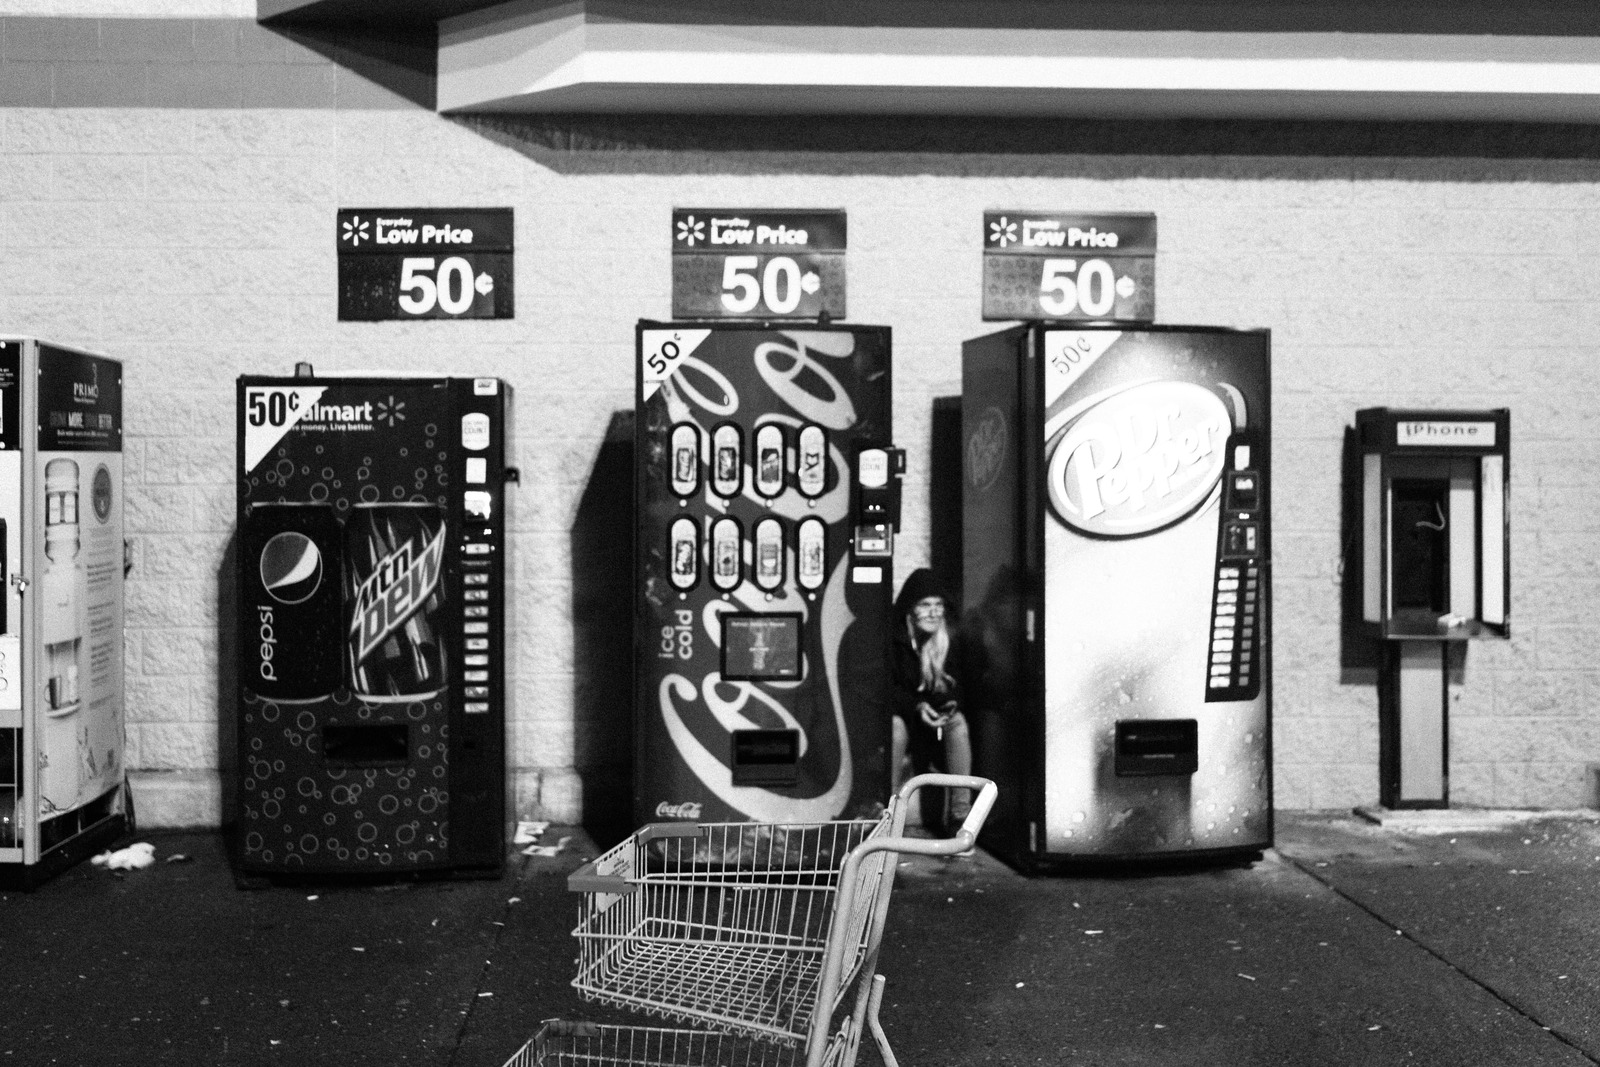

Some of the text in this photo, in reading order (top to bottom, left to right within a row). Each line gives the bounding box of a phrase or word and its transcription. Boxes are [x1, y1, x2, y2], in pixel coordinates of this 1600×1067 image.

[376, 223, 474, 244] Low Price
[710, 224, 809, 245] Low Price
[1022, 227, 1119, 247] Low Price
[248, 390, 300, 428] 50¢
[301, 401, 373, 422] almart
[330, 423, 346, 431] Live
[1406, 422, 1478, 437] iPhone
[1054, 417, 1221, 521] Pepper
[257, 604, 278, 681] pepsi
[658, 625, 675, 658] ice
[674, 609, 693, 660] cold
